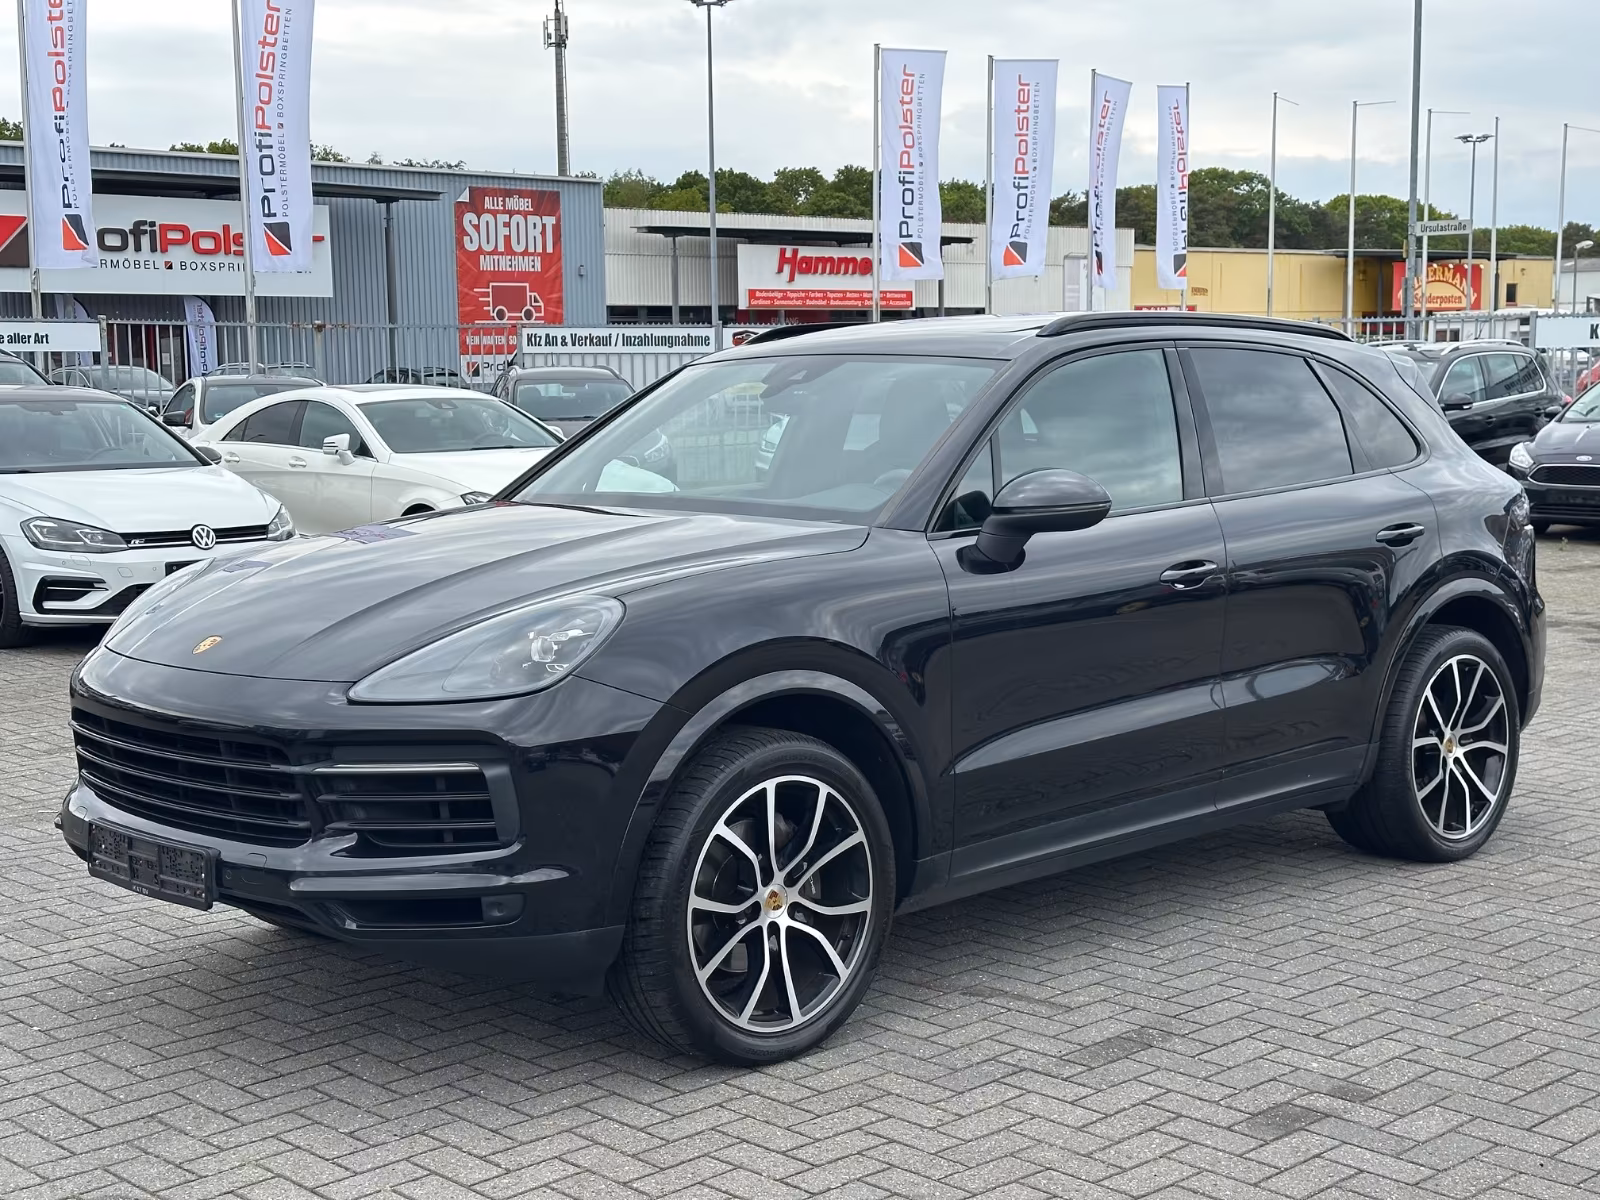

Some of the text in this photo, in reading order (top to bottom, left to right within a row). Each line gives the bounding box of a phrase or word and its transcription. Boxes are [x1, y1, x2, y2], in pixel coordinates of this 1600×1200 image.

[254, 0, 280, 217] ProfiPolster
[276, 8, 292, 217] POLSTERMÖBEL BOXSPRINGBETTEN
[898, 64, 915, 238] ProfiPolster
[1009, 74, 1030, 239] ProfiPolster
[484, 195, 534, 211] ALLE MÖBEL
[462, 212, 556, 253] SOFORT
[1420, 222, 1467, 233] Ursulastraße
[479, 254, 541, 272] MITNEHMEN
[776, 248, 873, 283] Hamme
[1413, 293, 1463, 306] Soderposten
[7, 332, 32, 344] aller
[34, 332, 49, 344] Art
[526, 333, 542, 347] Kfz
[544, 333, 558, 347] An
[560, 335, 568, 347] &
[570, 333, 612, 347] Verkauf
[621, 333, 710, 348] Inzahlungnahme
